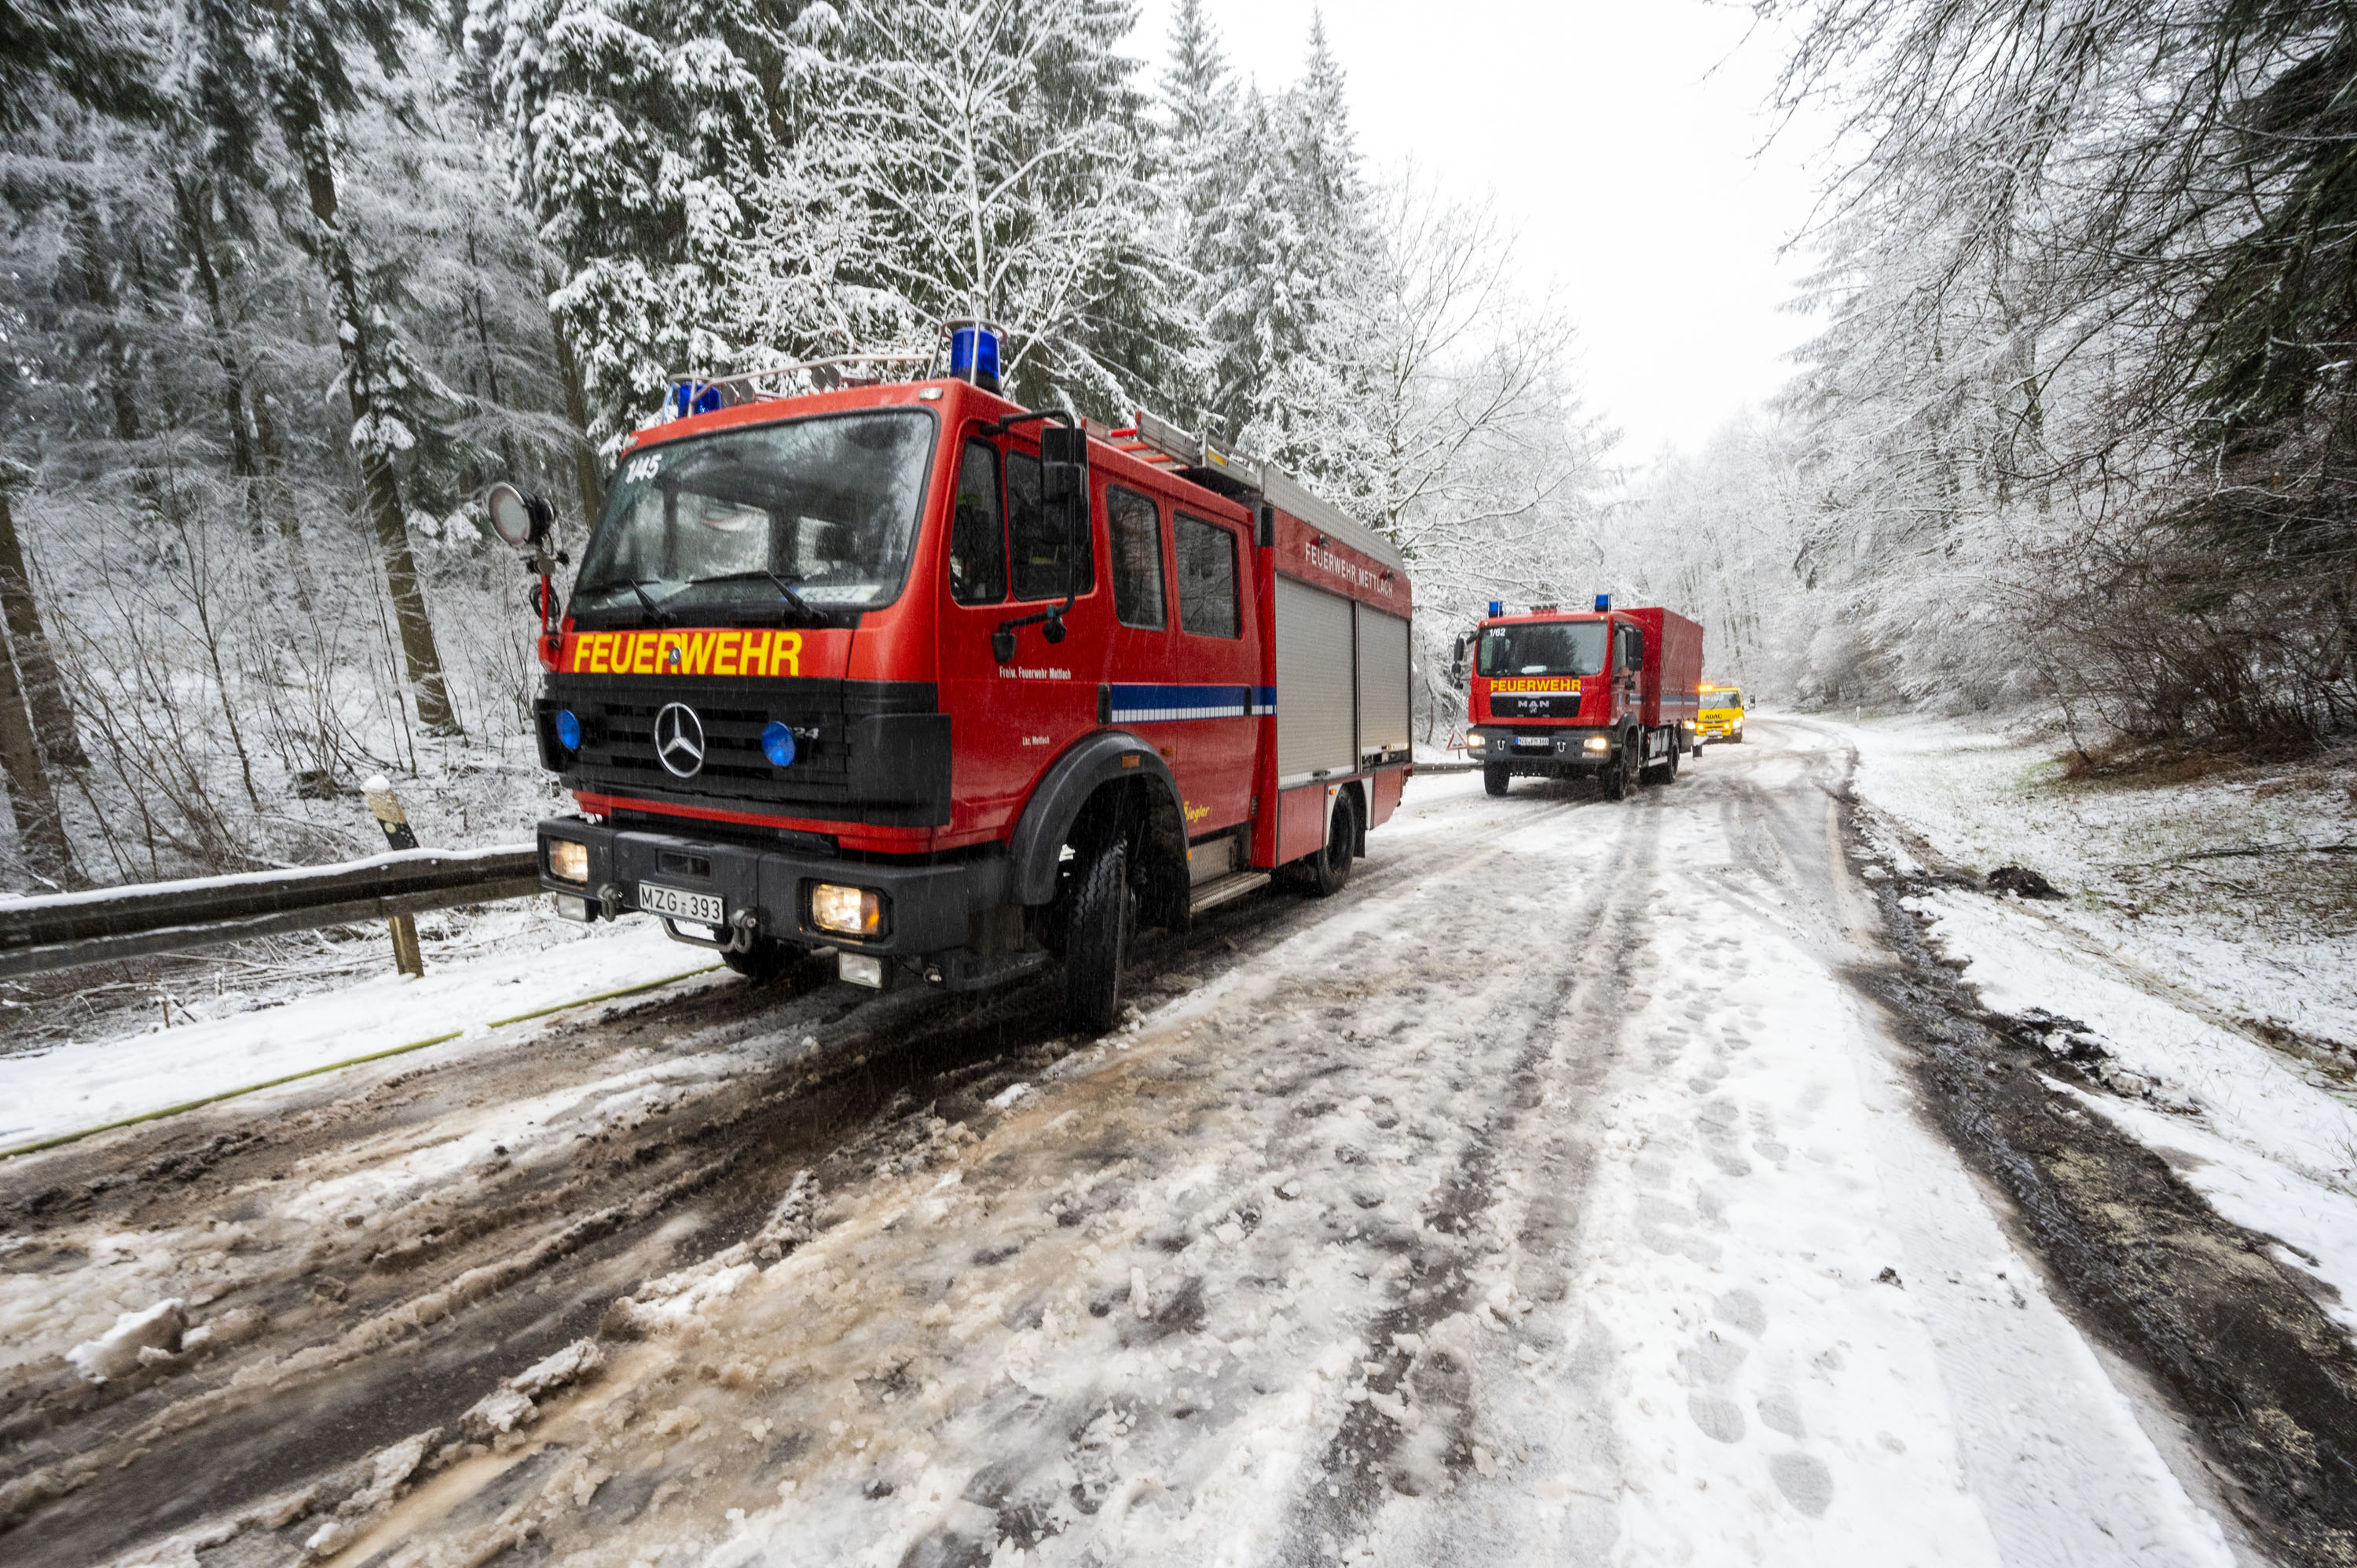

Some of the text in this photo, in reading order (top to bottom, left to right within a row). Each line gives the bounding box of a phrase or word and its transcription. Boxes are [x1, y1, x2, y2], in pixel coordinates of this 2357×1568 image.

[1305, 541, 1393, 597] FEUERWEHR METTLACH
[574, 631, 802, 676] FEUERWEHR
[1018, 665, 1047, 680] Feuerwehr
[1490, 680, 1582, 691] FEUERWEHR
[641, 886, 720, 919] MZG-393
